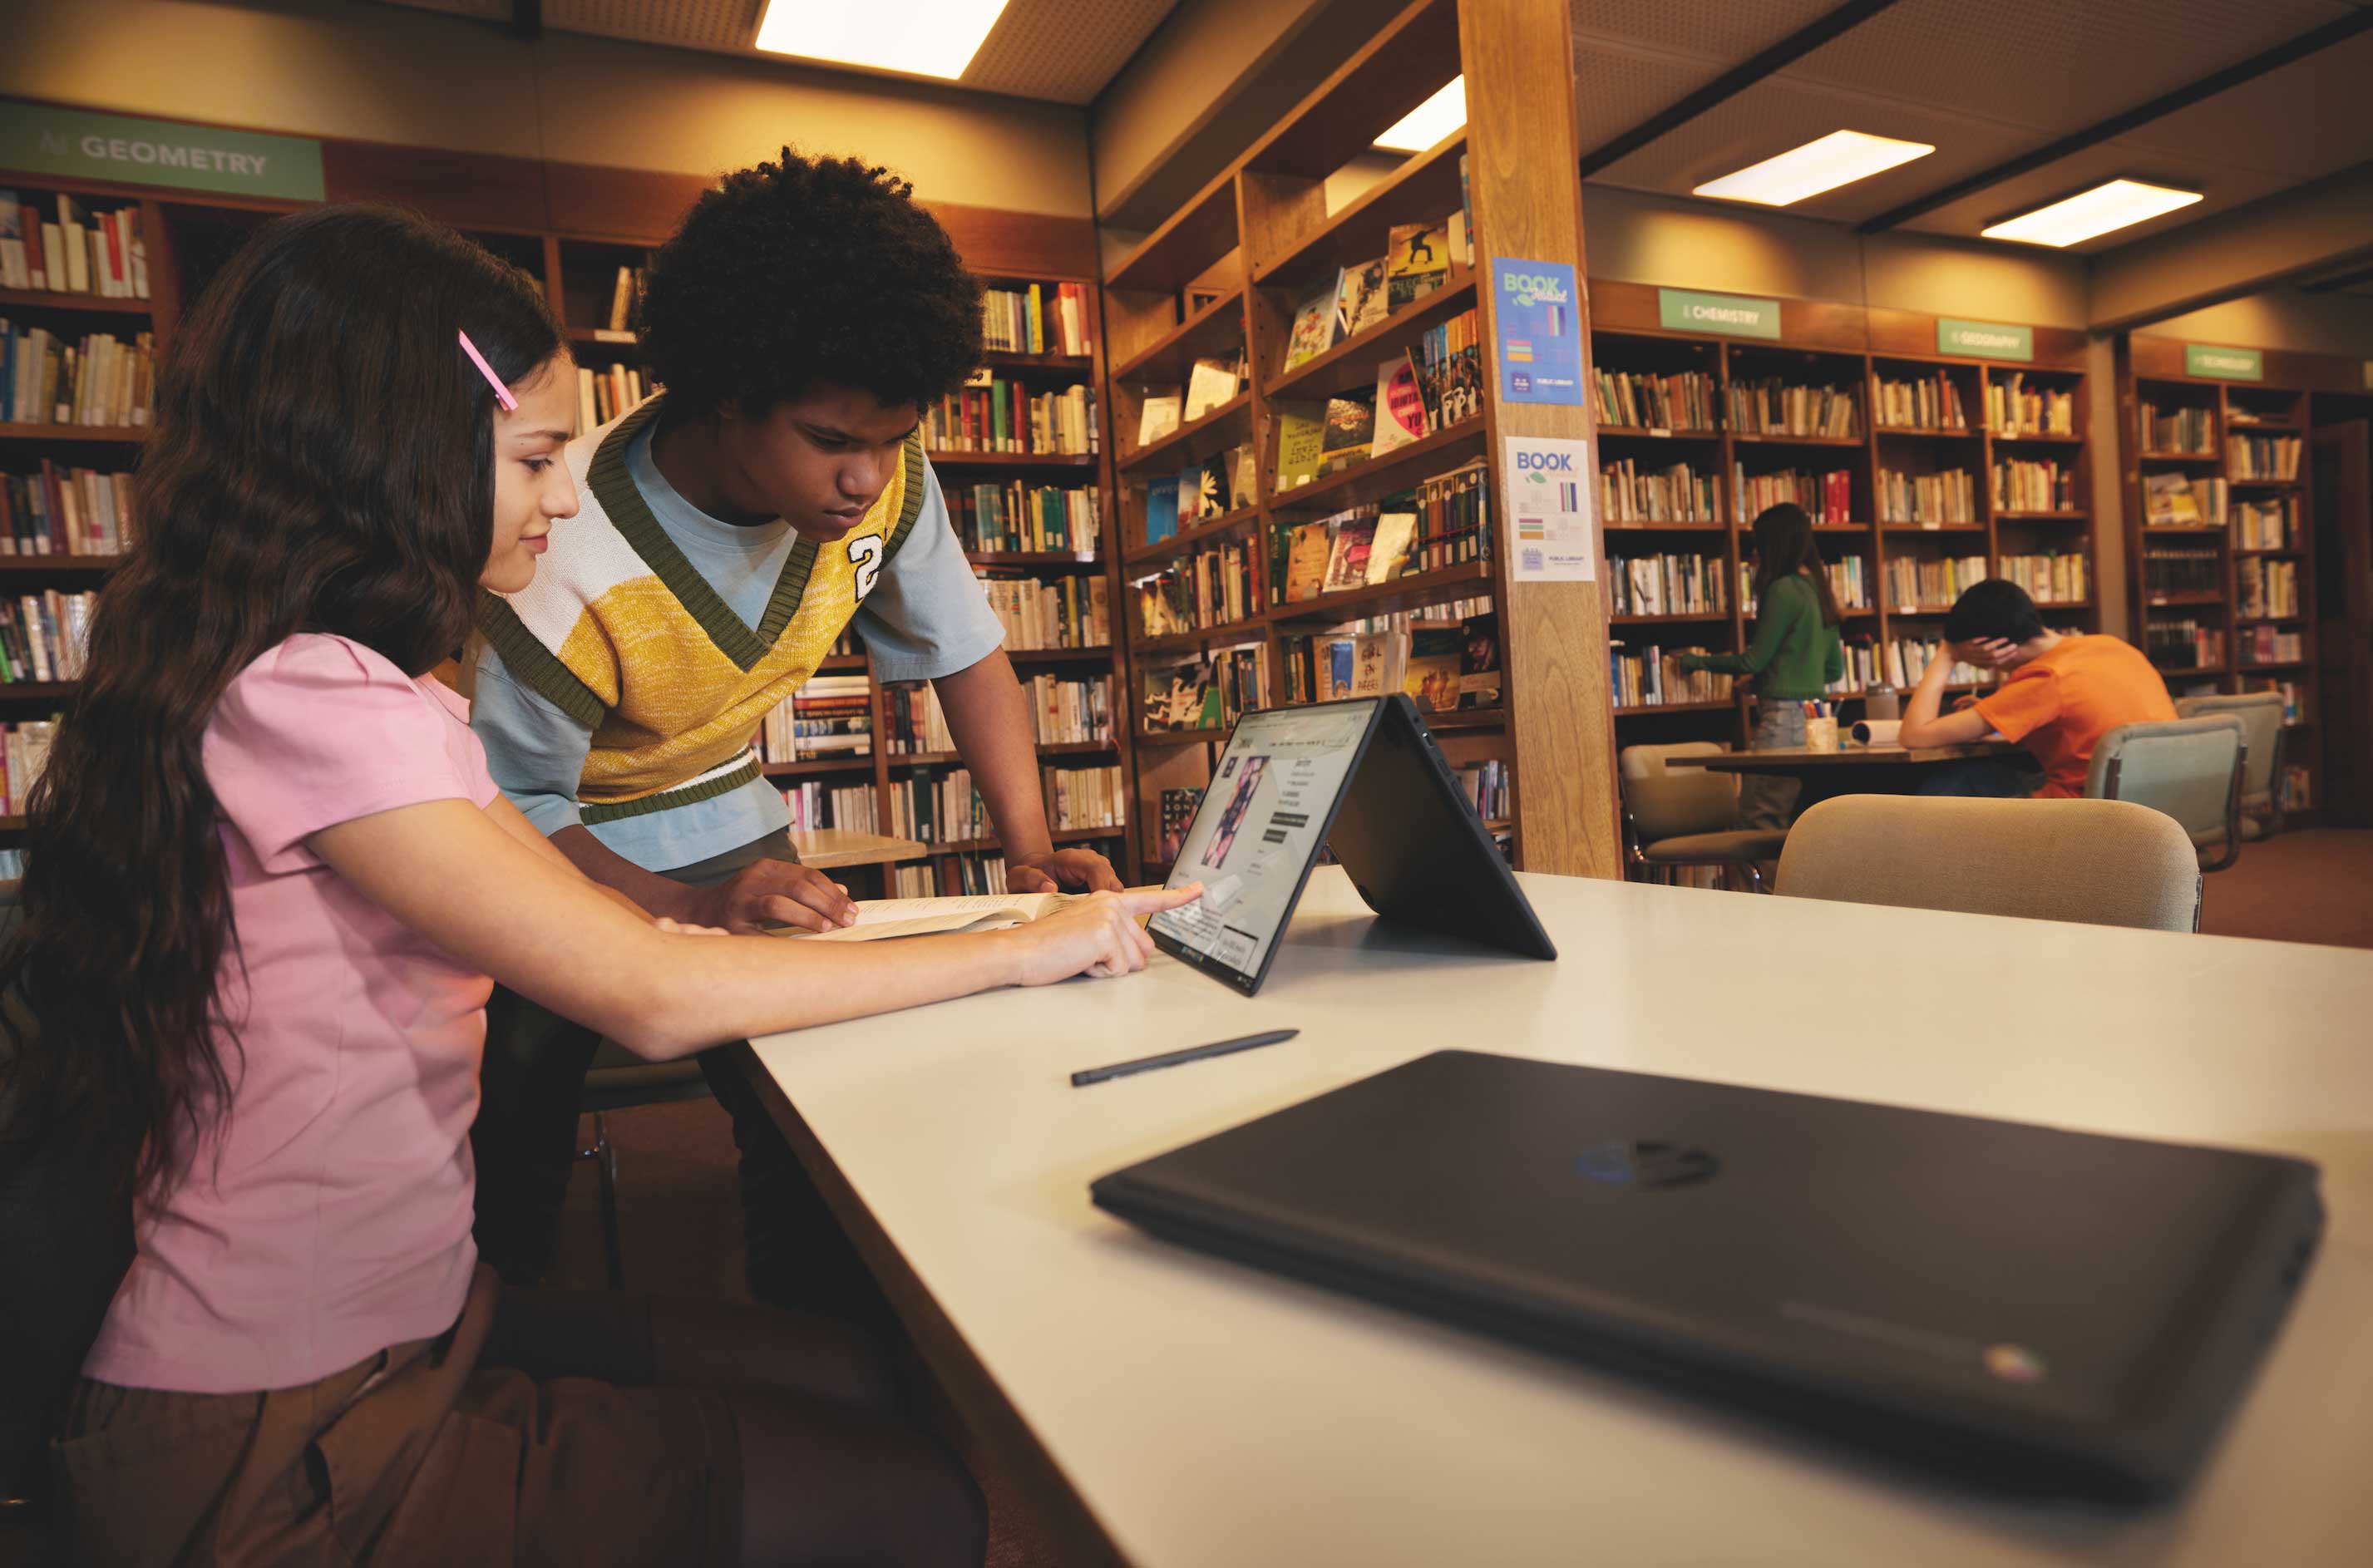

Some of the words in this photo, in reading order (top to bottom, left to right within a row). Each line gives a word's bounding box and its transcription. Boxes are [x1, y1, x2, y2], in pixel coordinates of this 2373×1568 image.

[79, 136, 269, 176] GEOMETRY
[1503, 272, 1560, 293] BOOK
[1692, 304, 1760, 325] CHEMISTRY
[1517, 451, 1572, 471] BOOK
[846, 534, 883, 604] 2
